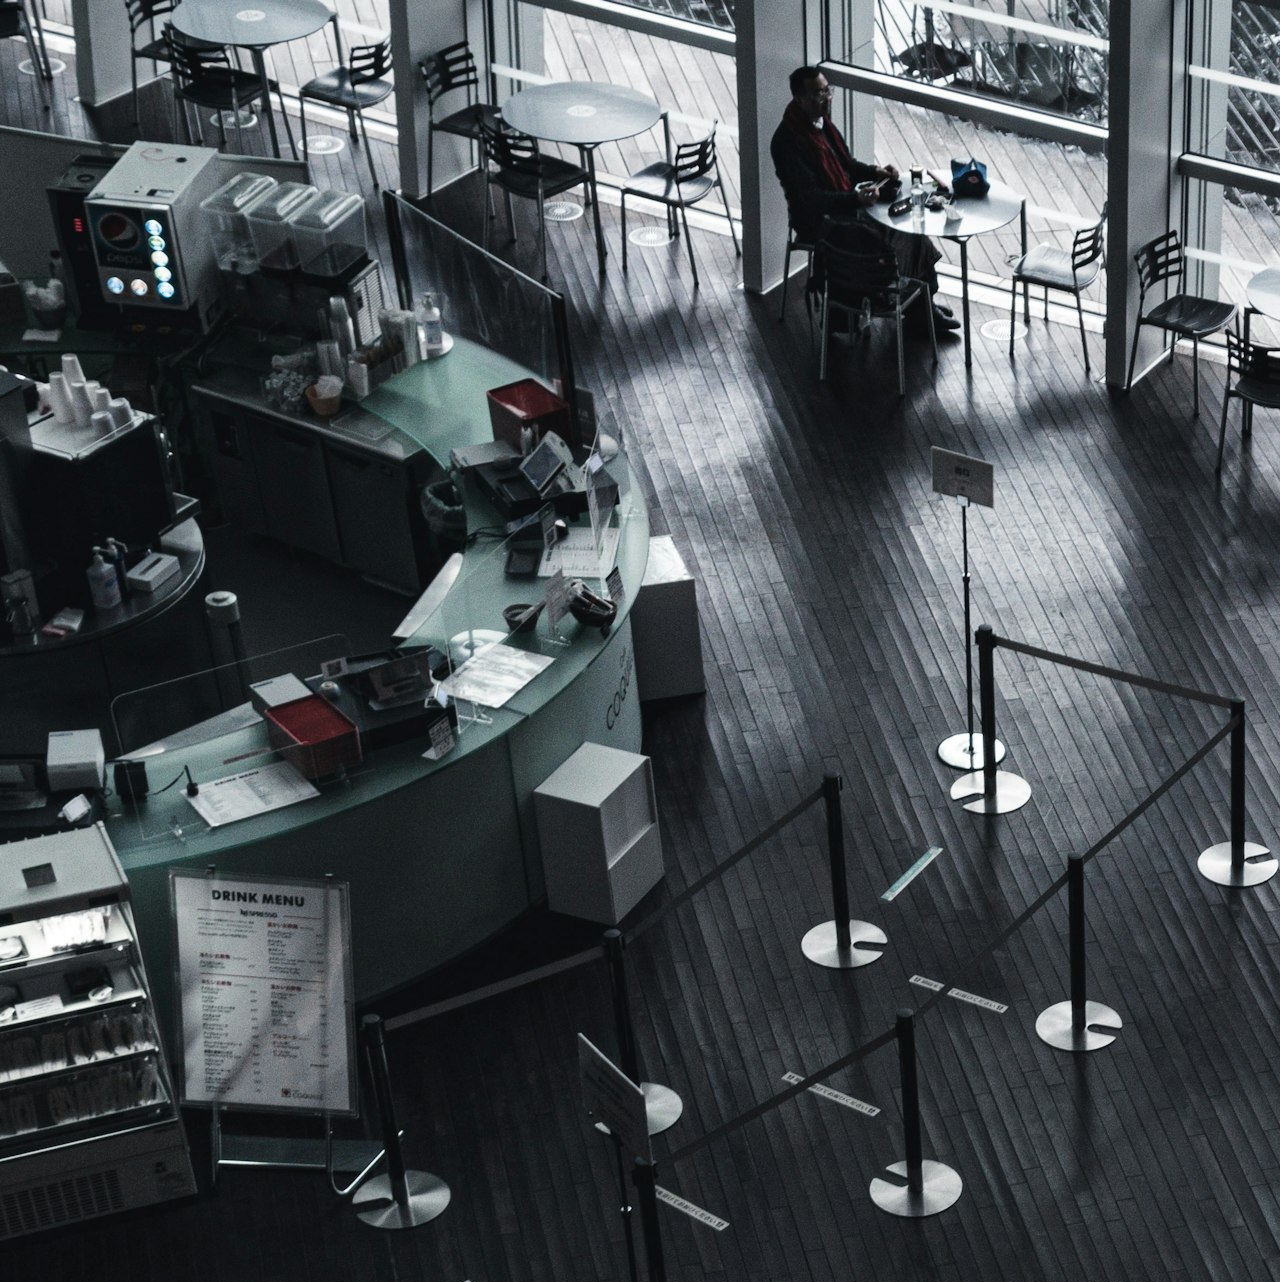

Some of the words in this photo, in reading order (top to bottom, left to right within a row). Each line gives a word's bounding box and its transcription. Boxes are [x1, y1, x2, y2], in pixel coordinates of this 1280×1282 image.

[106, 252, 143, 265] pepsi
[212, 889, 258, 903] DRINK
[262, 893, 305, 907] MENU
